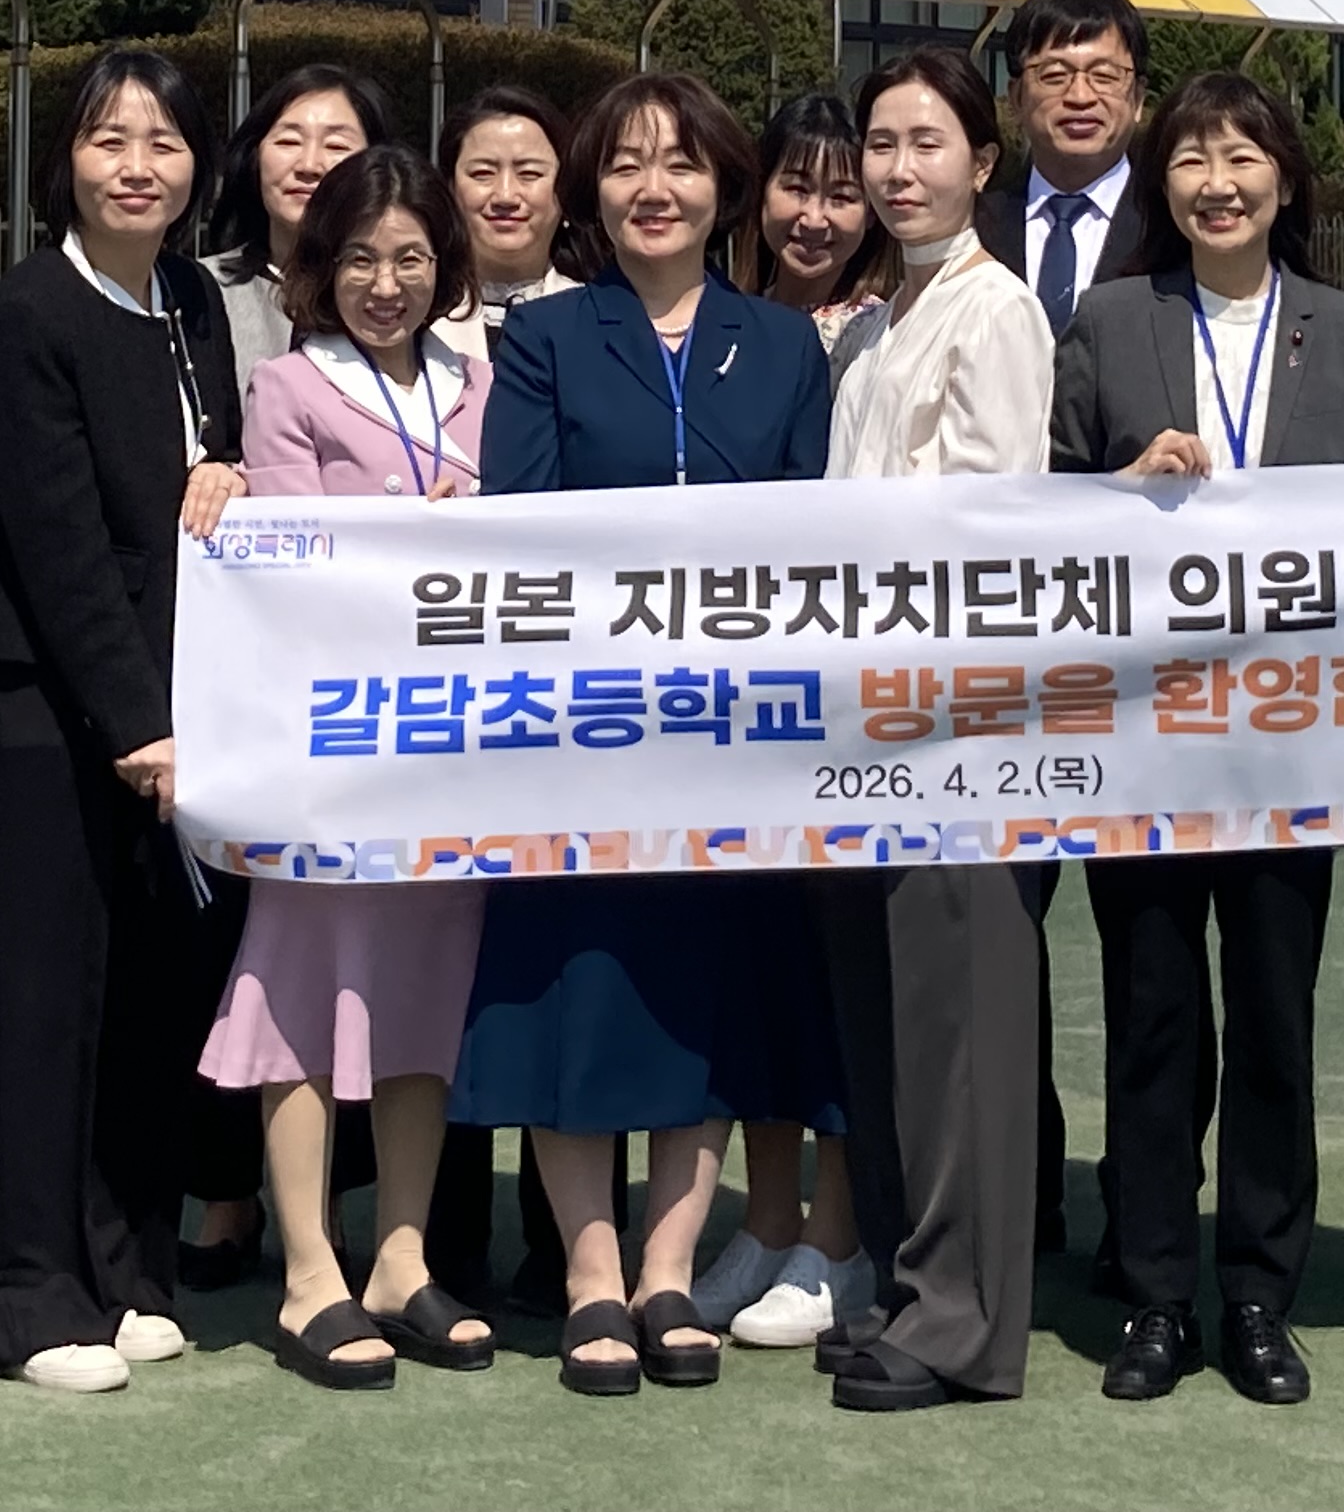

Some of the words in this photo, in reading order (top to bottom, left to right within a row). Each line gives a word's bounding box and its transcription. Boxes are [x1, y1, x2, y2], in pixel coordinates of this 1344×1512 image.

[411, 569, 577, 647] 일본
[609, 554, 1133, 641] 지방자치단체
[308, 667, 826, 758] 갈담초등학교
[859, 662, 1119, 743] 방문을
[814, 763, 925, 800] 2026.
[943, 763, 978, 798] 4.
[997, 754, 1104, 798] 2.(목)
